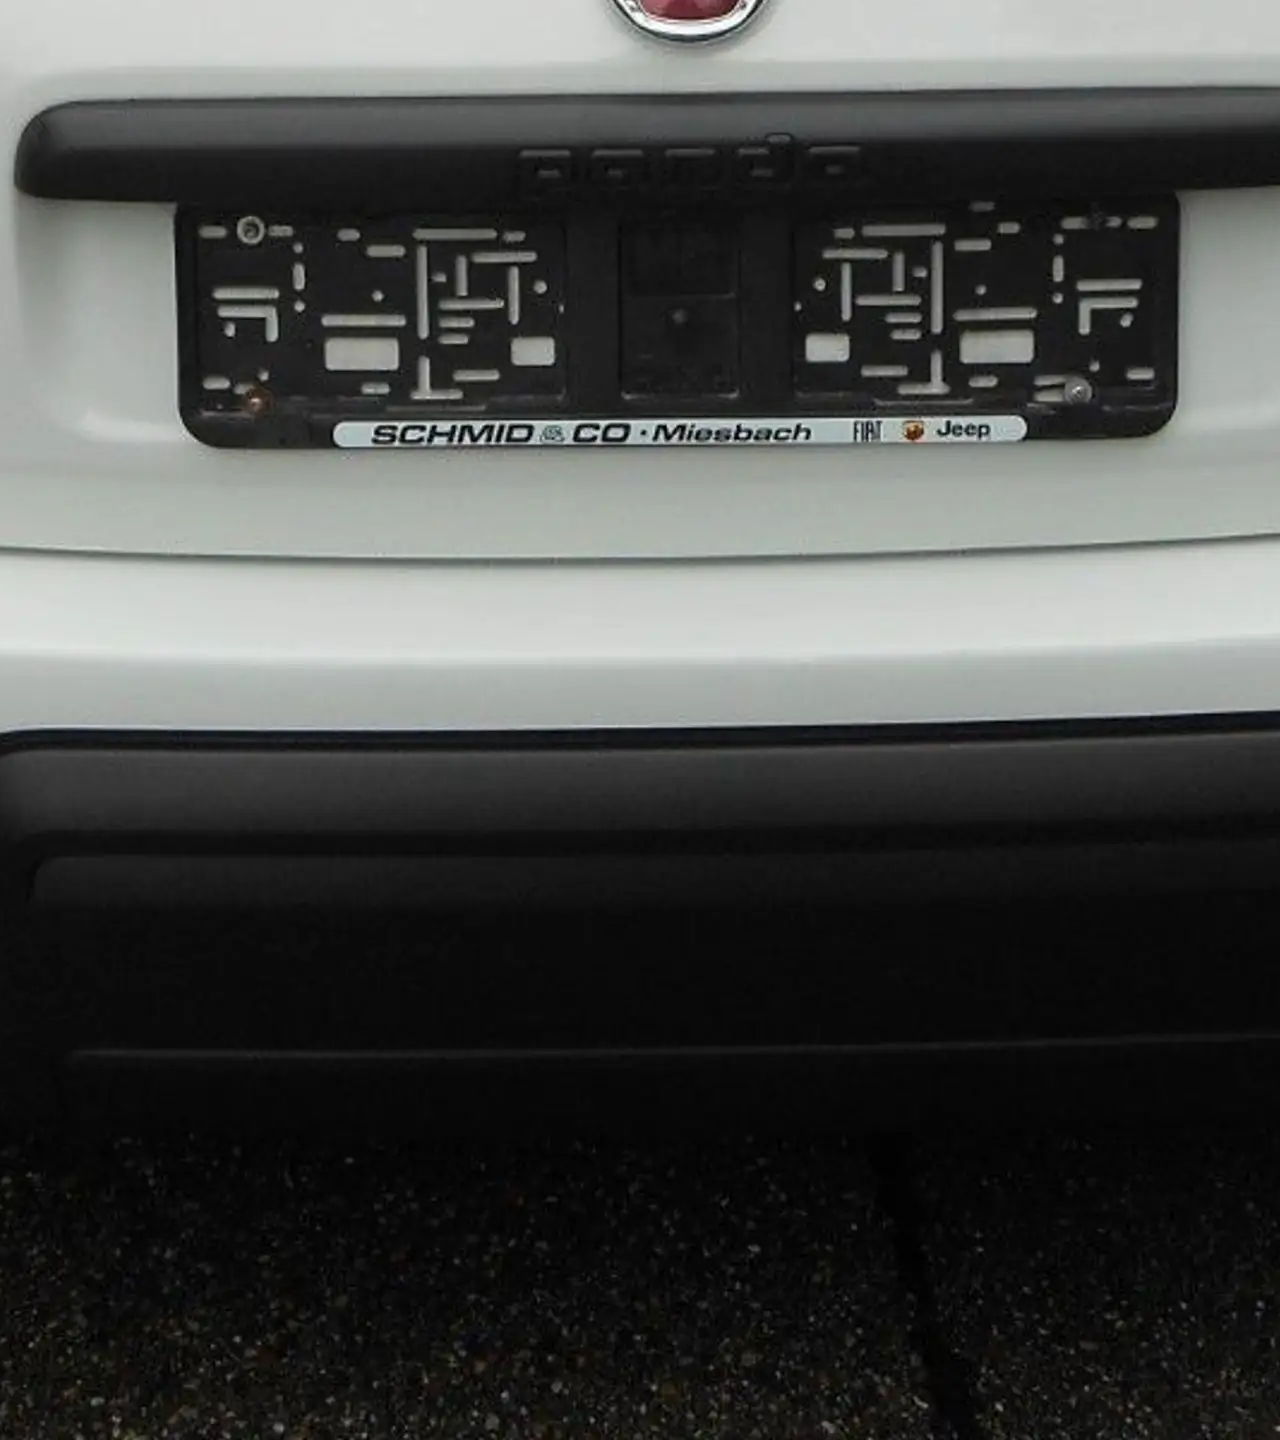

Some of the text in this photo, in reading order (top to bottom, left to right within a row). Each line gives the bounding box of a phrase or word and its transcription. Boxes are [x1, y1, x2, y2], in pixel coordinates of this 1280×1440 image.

[371, 423, 534, 444] SCHMID
[572, 422, 631, 443] CO
[652, 423, 812, 443] Miesbach
[853, 420, 884, 442] FIAT
[936, 420, 991, 440] Jeep
